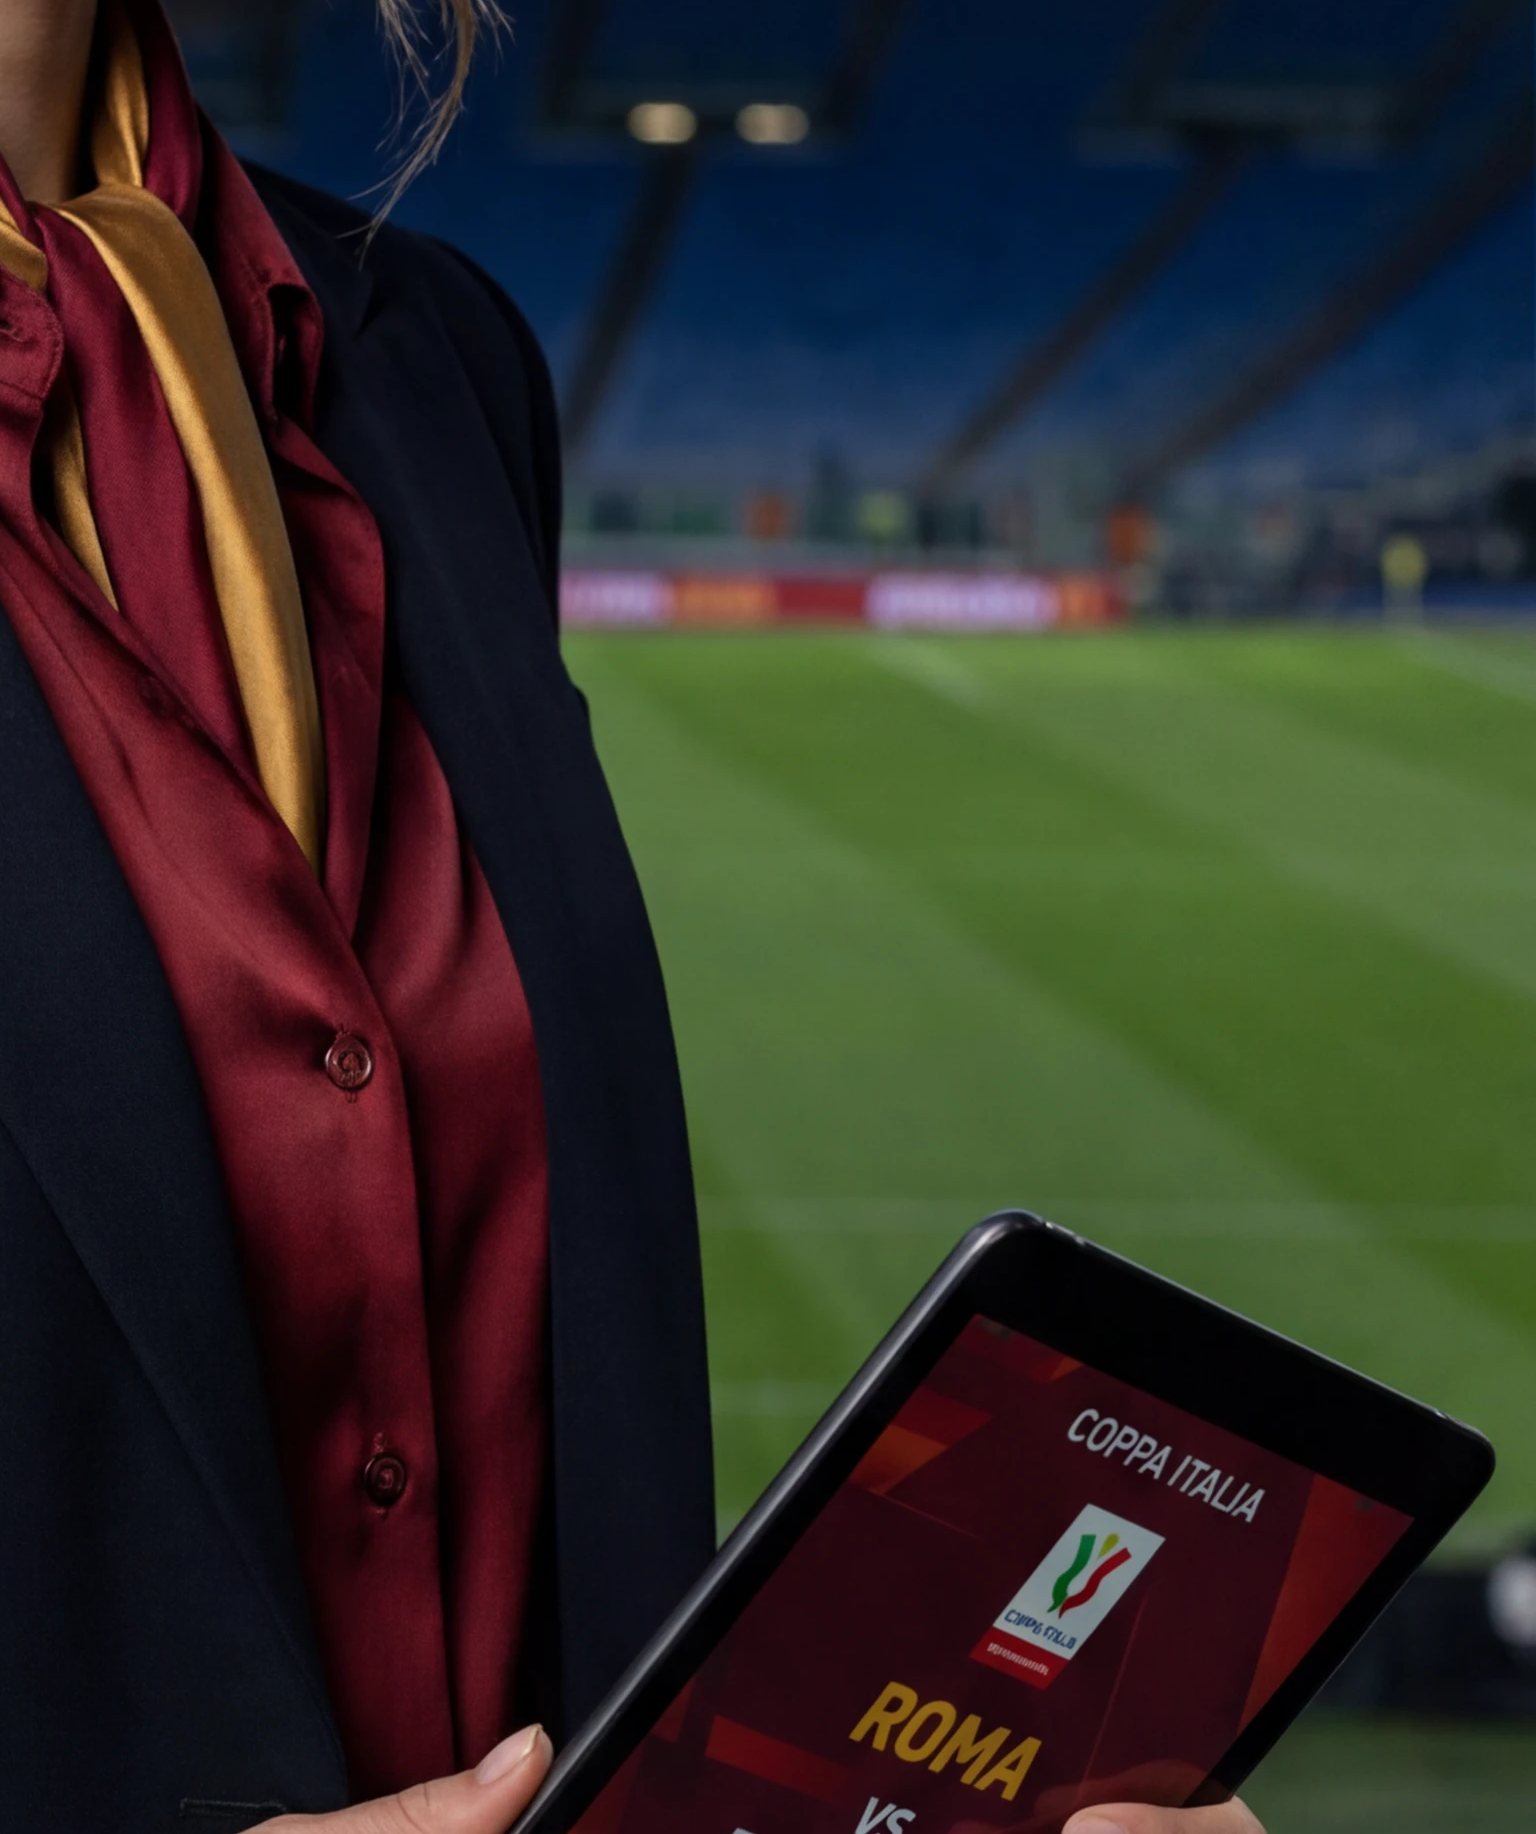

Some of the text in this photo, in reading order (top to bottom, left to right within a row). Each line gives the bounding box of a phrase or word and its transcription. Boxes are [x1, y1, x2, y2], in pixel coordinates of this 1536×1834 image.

[1067, 1408, 1266, 1523] COPPA ITALIA
[848, 1680, 1042, 1802] ROMA
